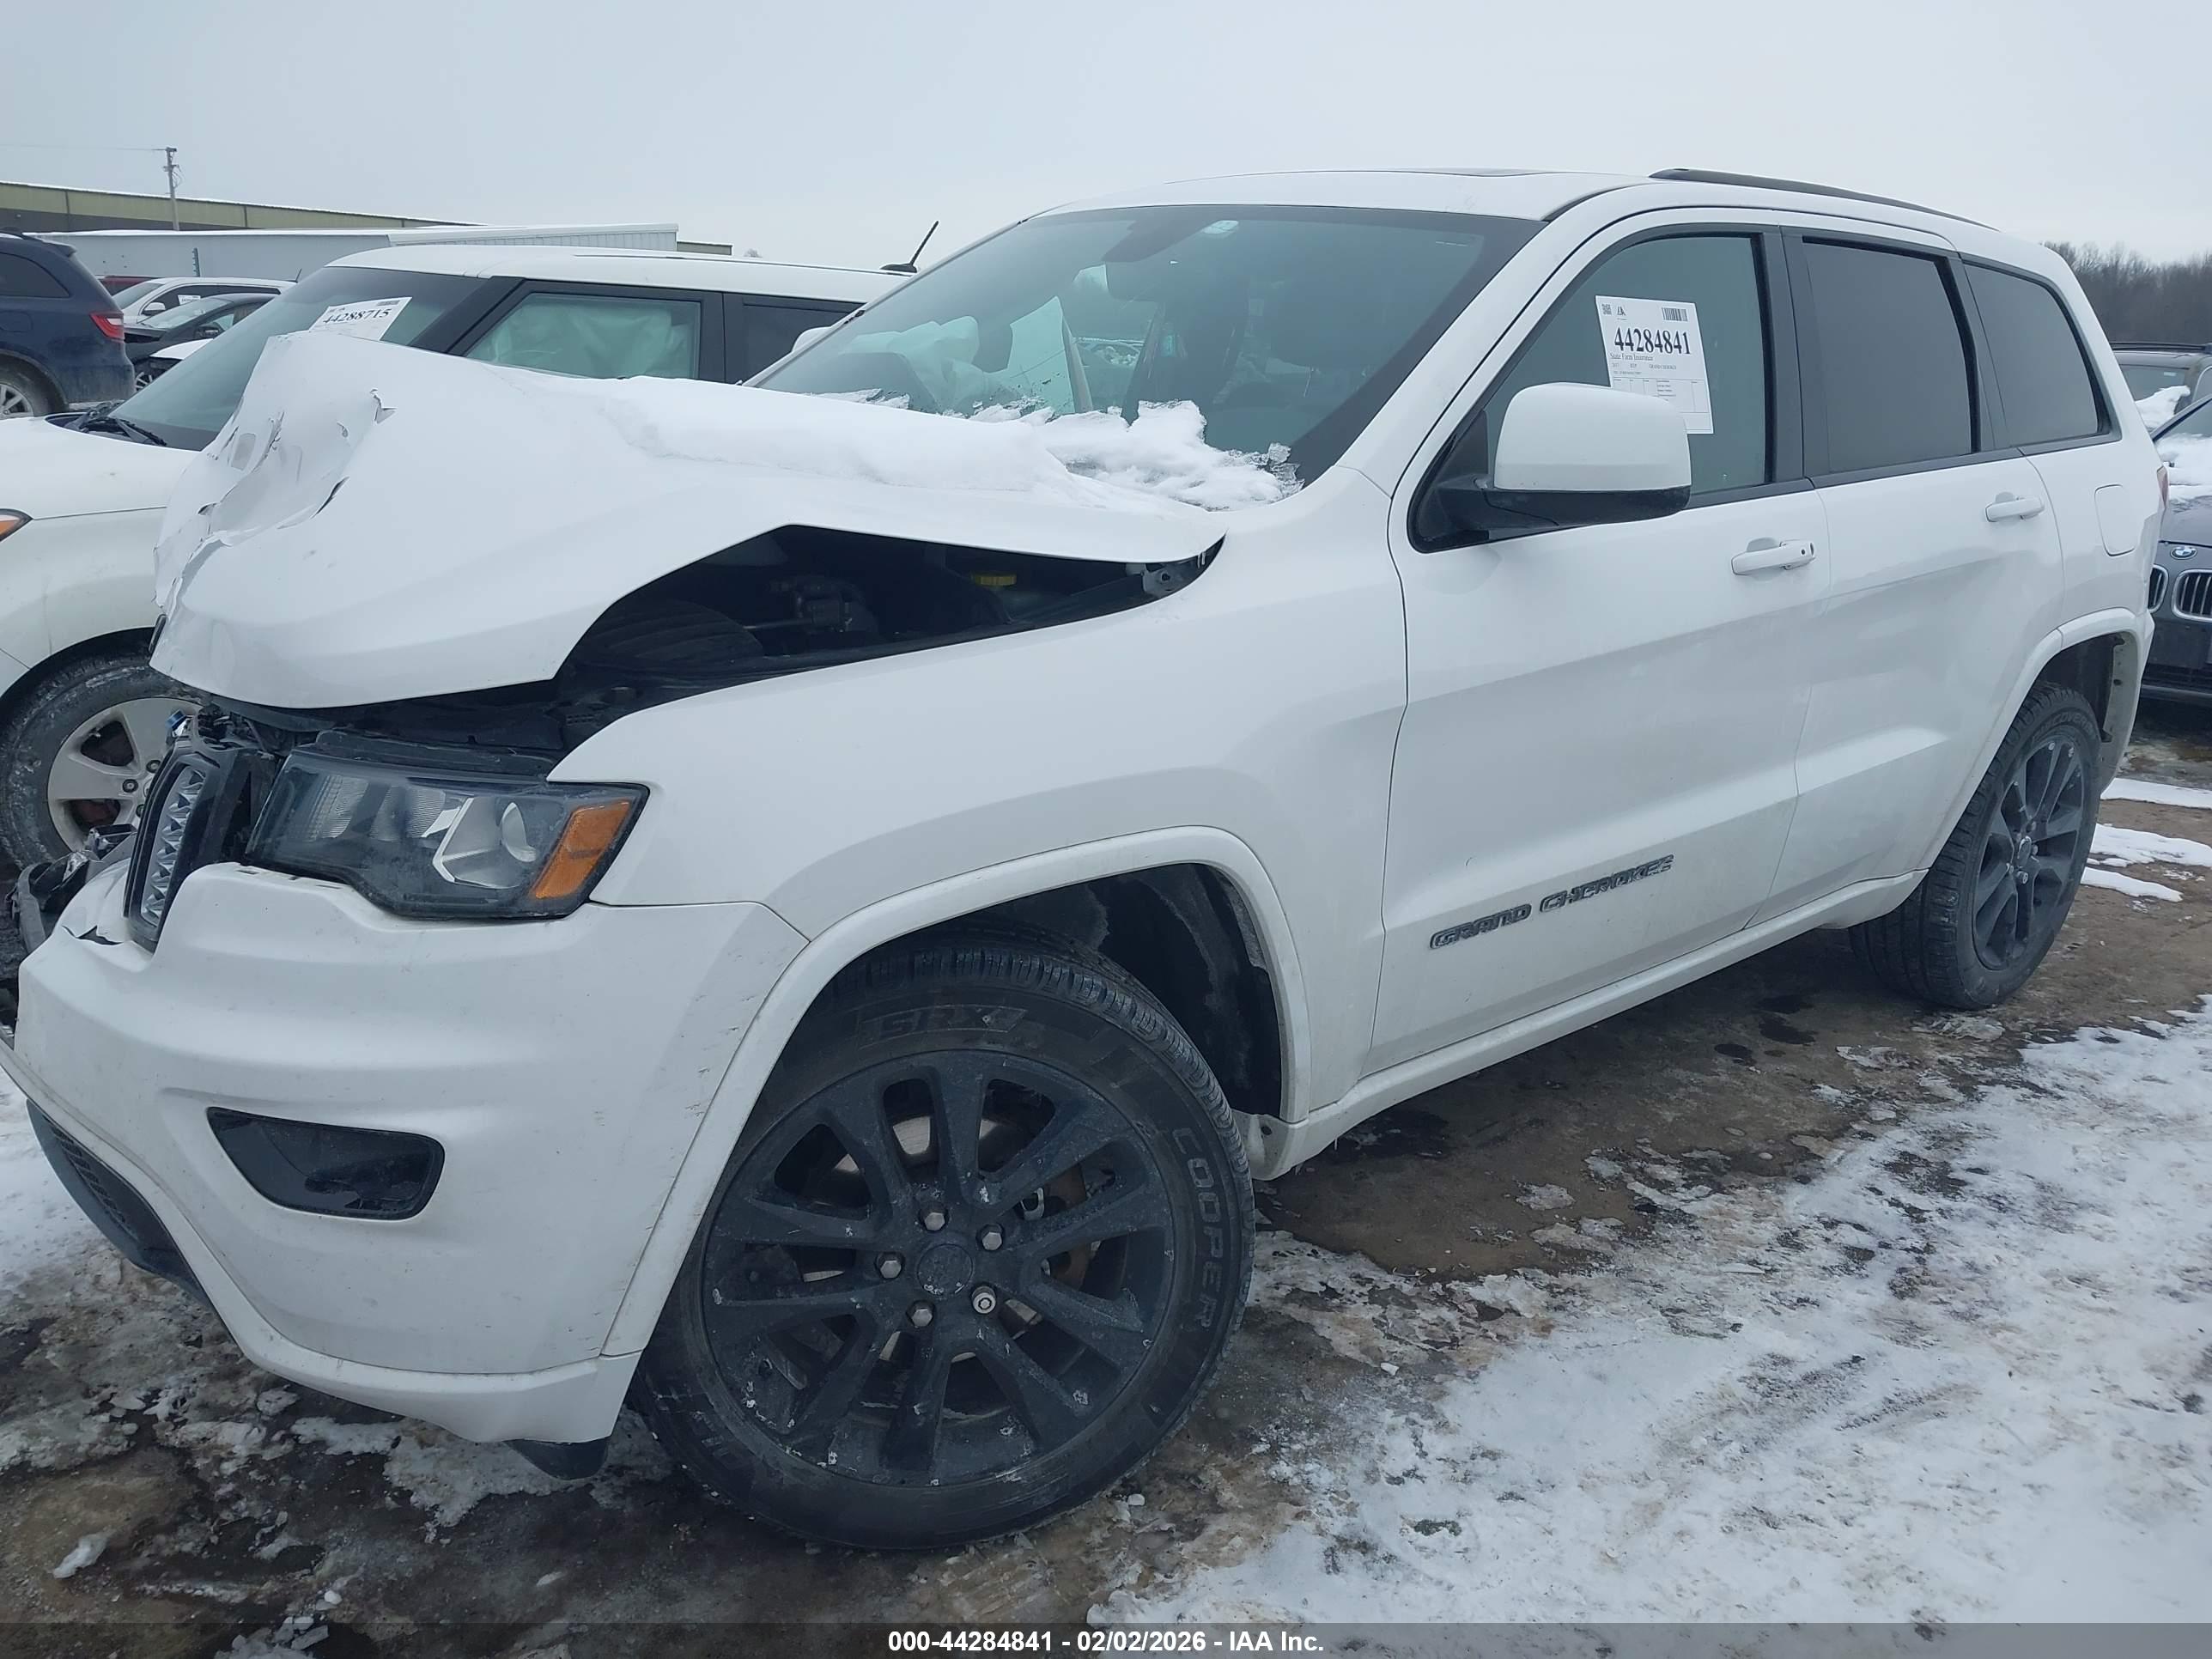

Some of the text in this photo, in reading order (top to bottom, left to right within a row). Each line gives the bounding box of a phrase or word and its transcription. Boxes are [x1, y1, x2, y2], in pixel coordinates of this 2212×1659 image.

[323, 308, 392, 324] 44288715
[1614, 327, 1691, 355] 44284841
[1430, 854, 1674, 950] GRAND CHEROKEE
[1172, 1127, 1224, 1328] COOPER
